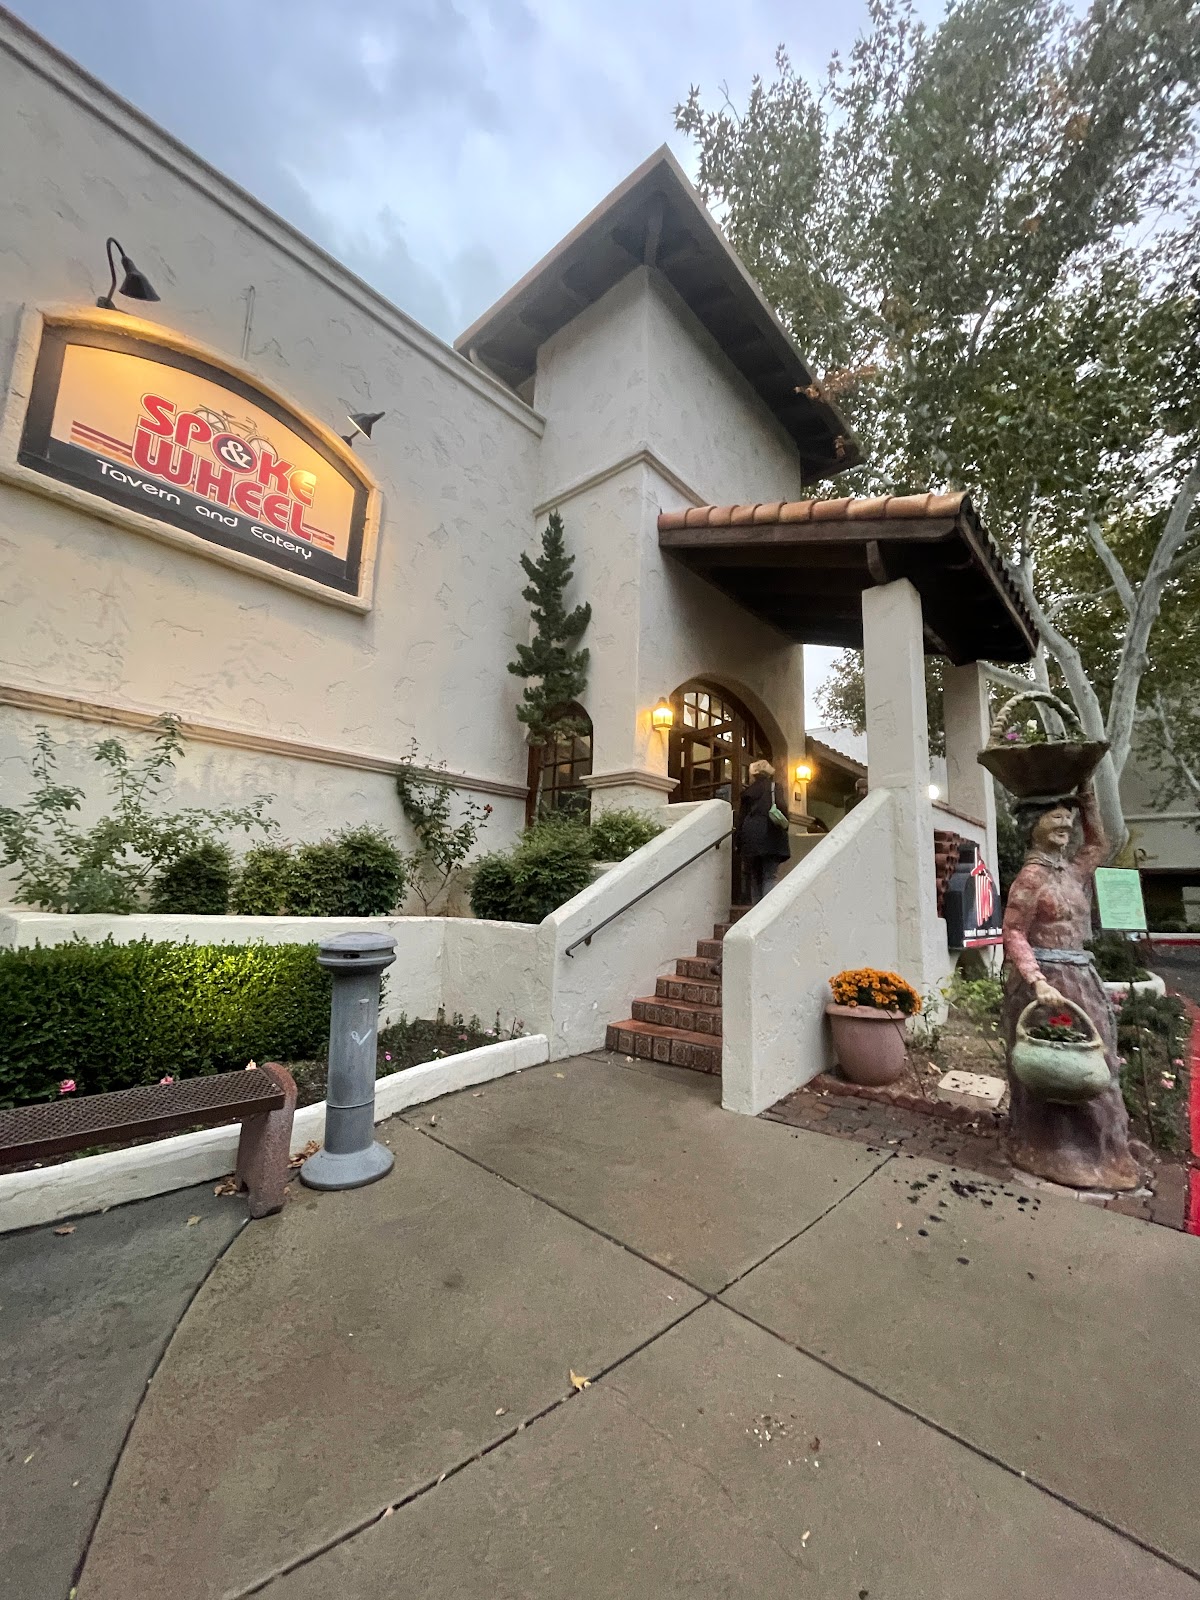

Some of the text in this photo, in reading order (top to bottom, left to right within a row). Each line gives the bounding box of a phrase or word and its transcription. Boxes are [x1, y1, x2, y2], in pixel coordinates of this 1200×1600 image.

[132, 426, 313, 542] WHEEL
[138, 393, 317, 507] SPOKE
[220, 440, 252, 469] &
[96, 459, 312, 560] Tavern and Eatery
